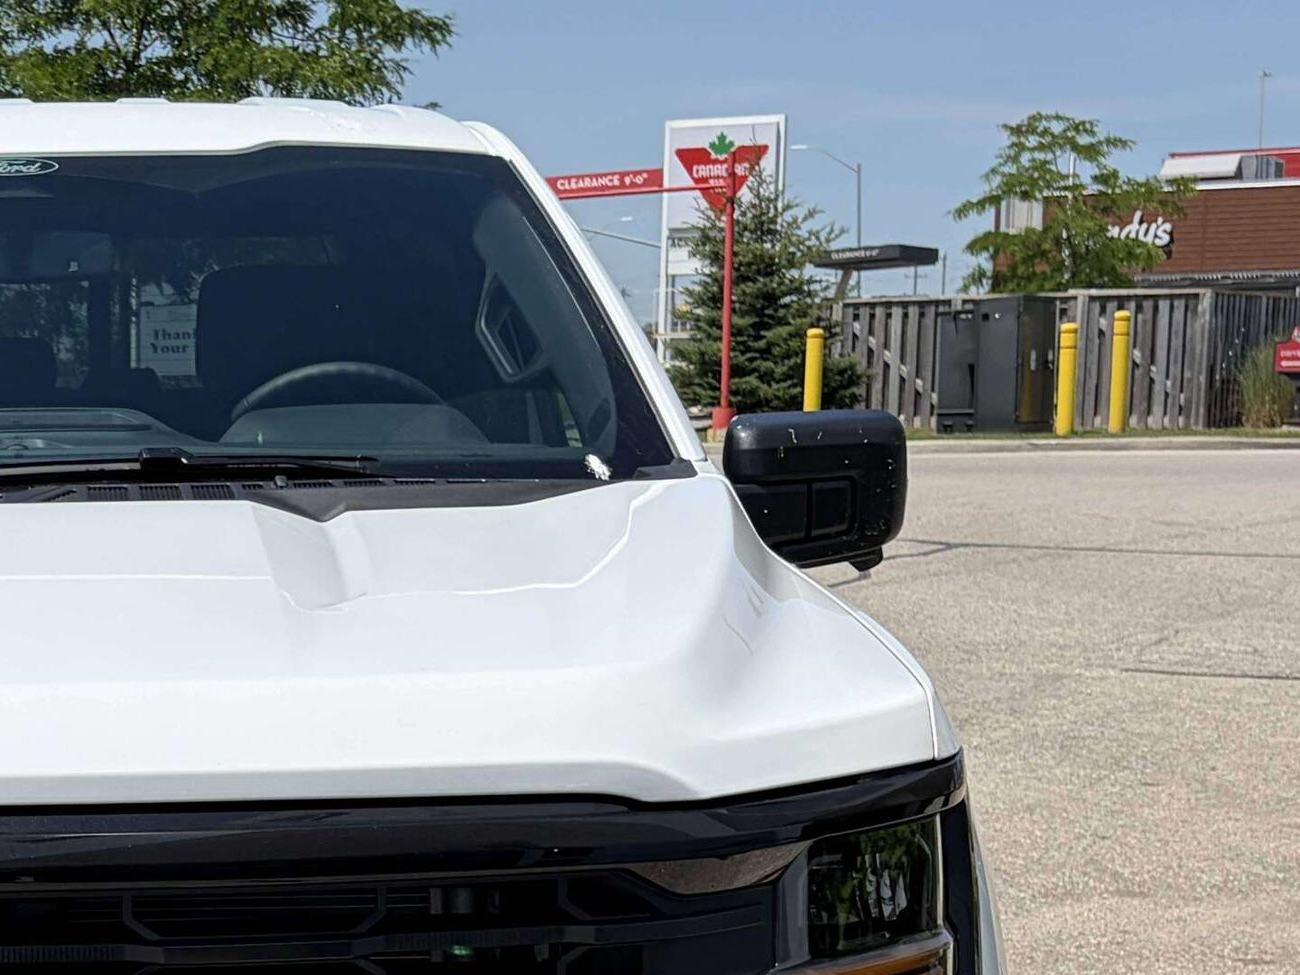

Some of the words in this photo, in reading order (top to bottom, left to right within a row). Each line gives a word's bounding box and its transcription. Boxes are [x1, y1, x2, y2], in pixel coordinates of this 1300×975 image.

[556, 174, 621, 190] CLEARANCE
[1105, 209, 1173, 247] ndy's
[150, 342, 189, 354] Your
